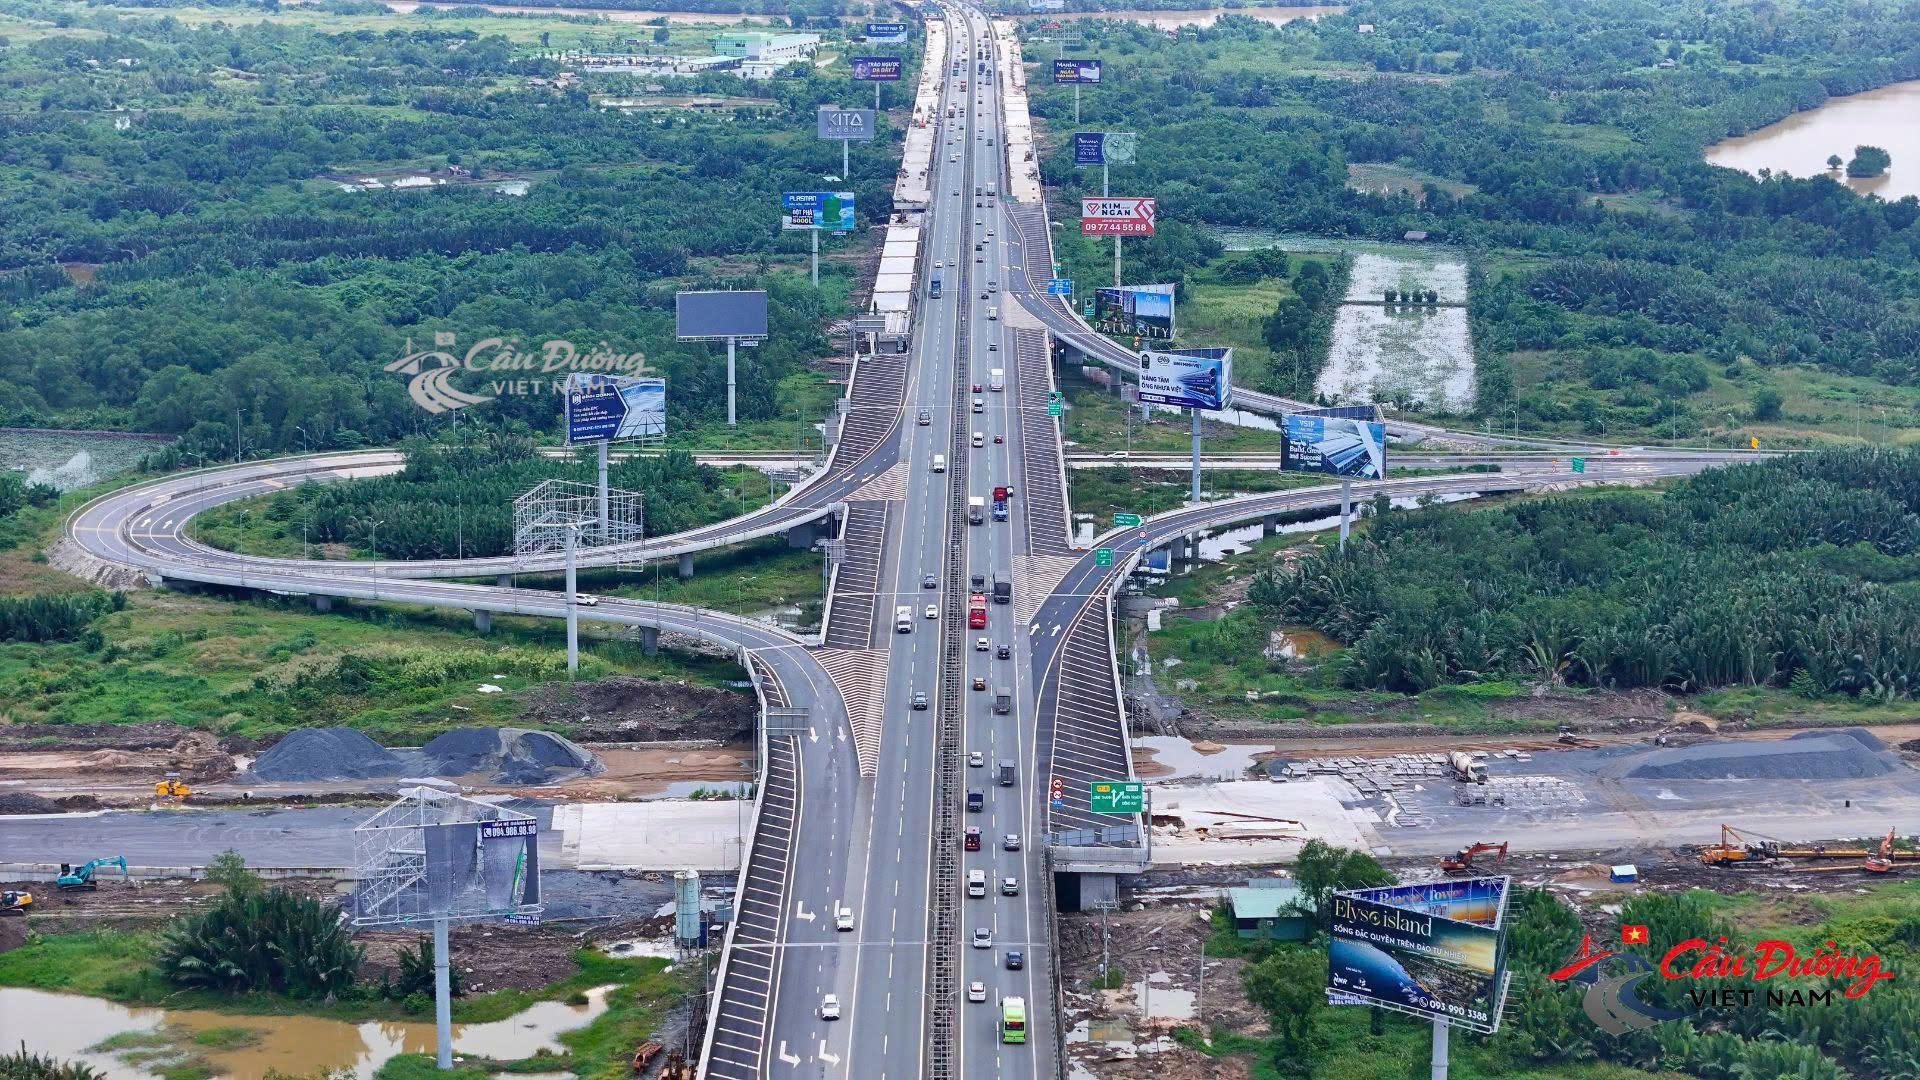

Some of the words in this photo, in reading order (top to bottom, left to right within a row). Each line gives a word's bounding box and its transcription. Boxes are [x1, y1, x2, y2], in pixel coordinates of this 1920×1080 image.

[1095, 322, 1130, 334] PALM
[1137, 325, 1168, 338] CITY
[1384, 910, 1432, 937] island
[1333, 924, 1353, 935] SỐNG
[1355, 928, 1369, 939] ĐẶC
[1370, 933, 1395, 944] QUYỀN
[1397, 939, 1415, 949] TRÊN
[1430, 1000, 1446, 1011] 093
[1448, 1005, 1464, 1015] 990
[1467, 1009, 1487, 1021] 3388
